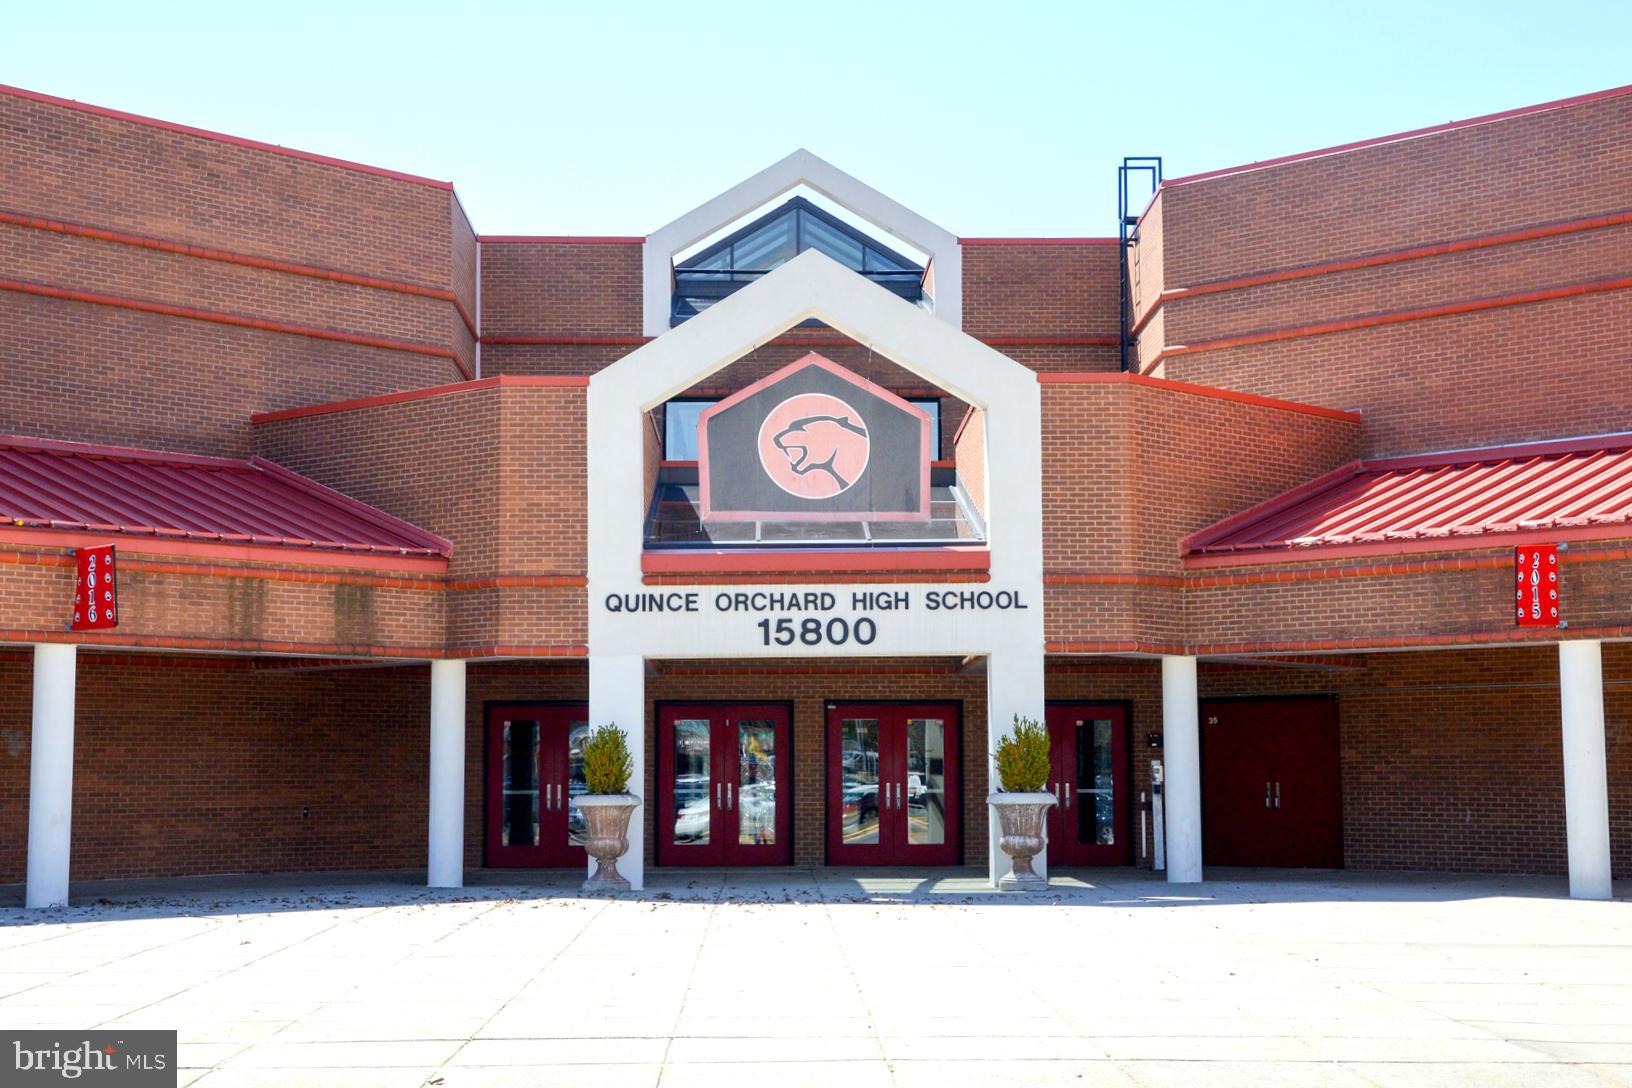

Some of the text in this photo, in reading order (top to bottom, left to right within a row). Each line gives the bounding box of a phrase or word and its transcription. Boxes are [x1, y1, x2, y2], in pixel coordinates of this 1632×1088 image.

[87, 554, 97, 622] 2016
[605, 590, 1028, 613] QUINCE ORCHARD HIGH SCHOOL
[1530, 552, 1541, 619] 2015
[757, 617, 877, 647] 15800
